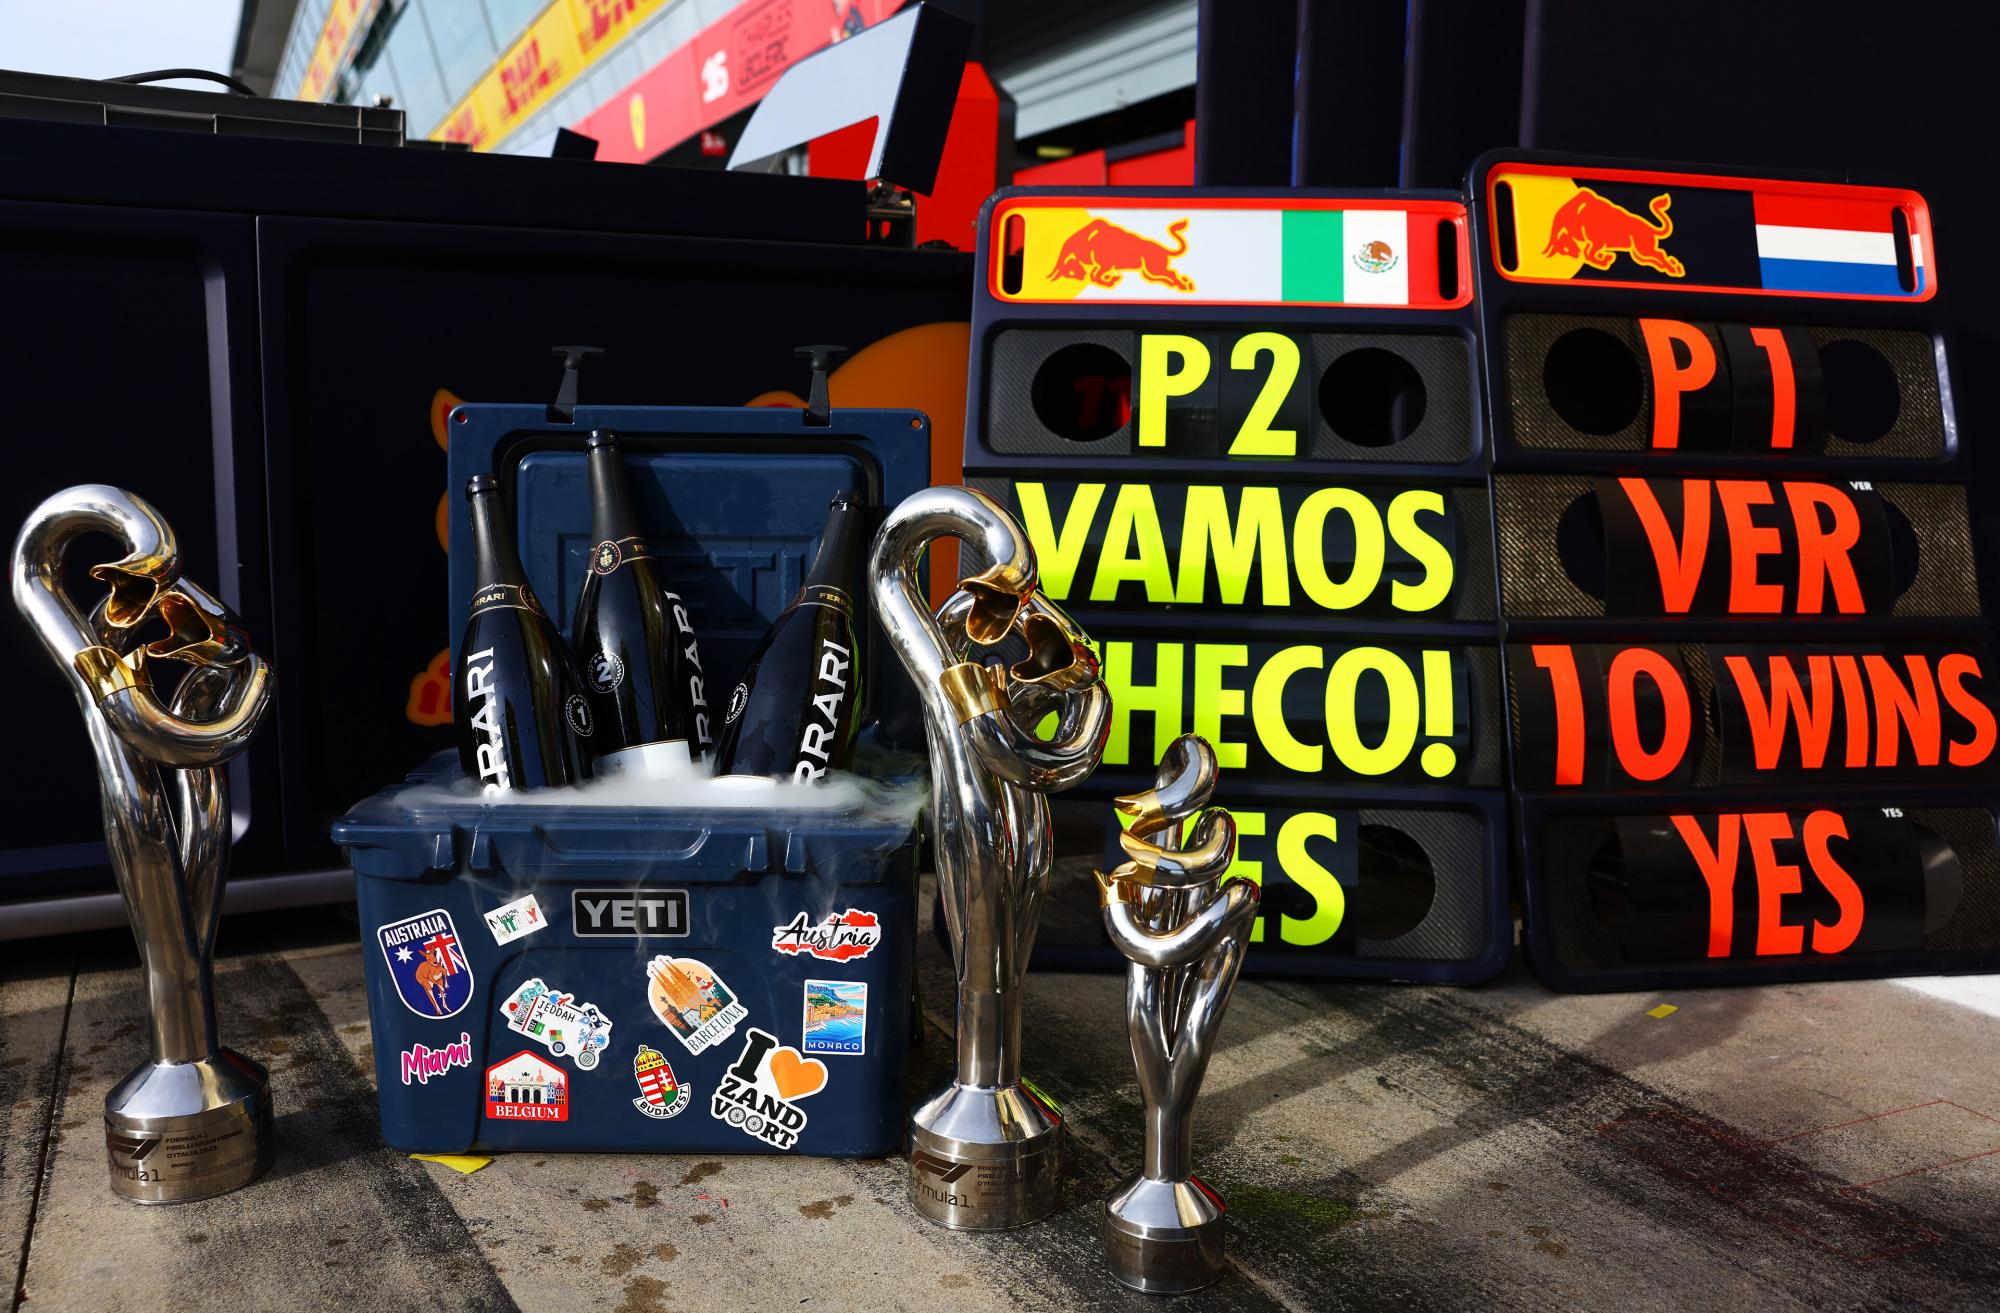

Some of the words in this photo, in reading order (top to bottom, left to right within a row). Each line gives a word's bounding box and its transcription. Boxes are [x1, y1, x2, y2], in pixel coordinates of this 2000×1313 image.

[701, 50, 729, 103] 16
[1850, 481, 1873, 491] VER
[1015, 482, 1454, 612] VAMOS
[1618, 477, 1867, 615] VER
[596, 661, 612, 683] 2
[665, 591, 713, 762] RRARI
[466, 647, 511, 799] RRARI
[577, 705, 587, 726] 1
[730, 693, 739, 713] 1
[793, 638, 850, 786] RRARI
[1531, 644, 1692, 786] 10
[1724, 653, 1998, 770] WINS
[1882, 808, 1904, 818] YES
[1670, 810, 1865, 958] YES
[384, 915, 448, 948] AUSTRALIA
[580, 900, 678, 928] YETI
[776, 914, 878, 951] Austria
[537, 1000, 577, 1023] JEDDAH
[687, 1002, 745, 1052] BARCELONA
[402, 1034, 470, 1083] Miami
[730, 1031, 777, 1084] I
[808, 1041, 860, 1050] MONACO
[495, 1105, 560, 1119] BELGIUM
[639, 1088, 688, 1116] BUDAPEST
[719, 1077, 804, 1131] ZAND
